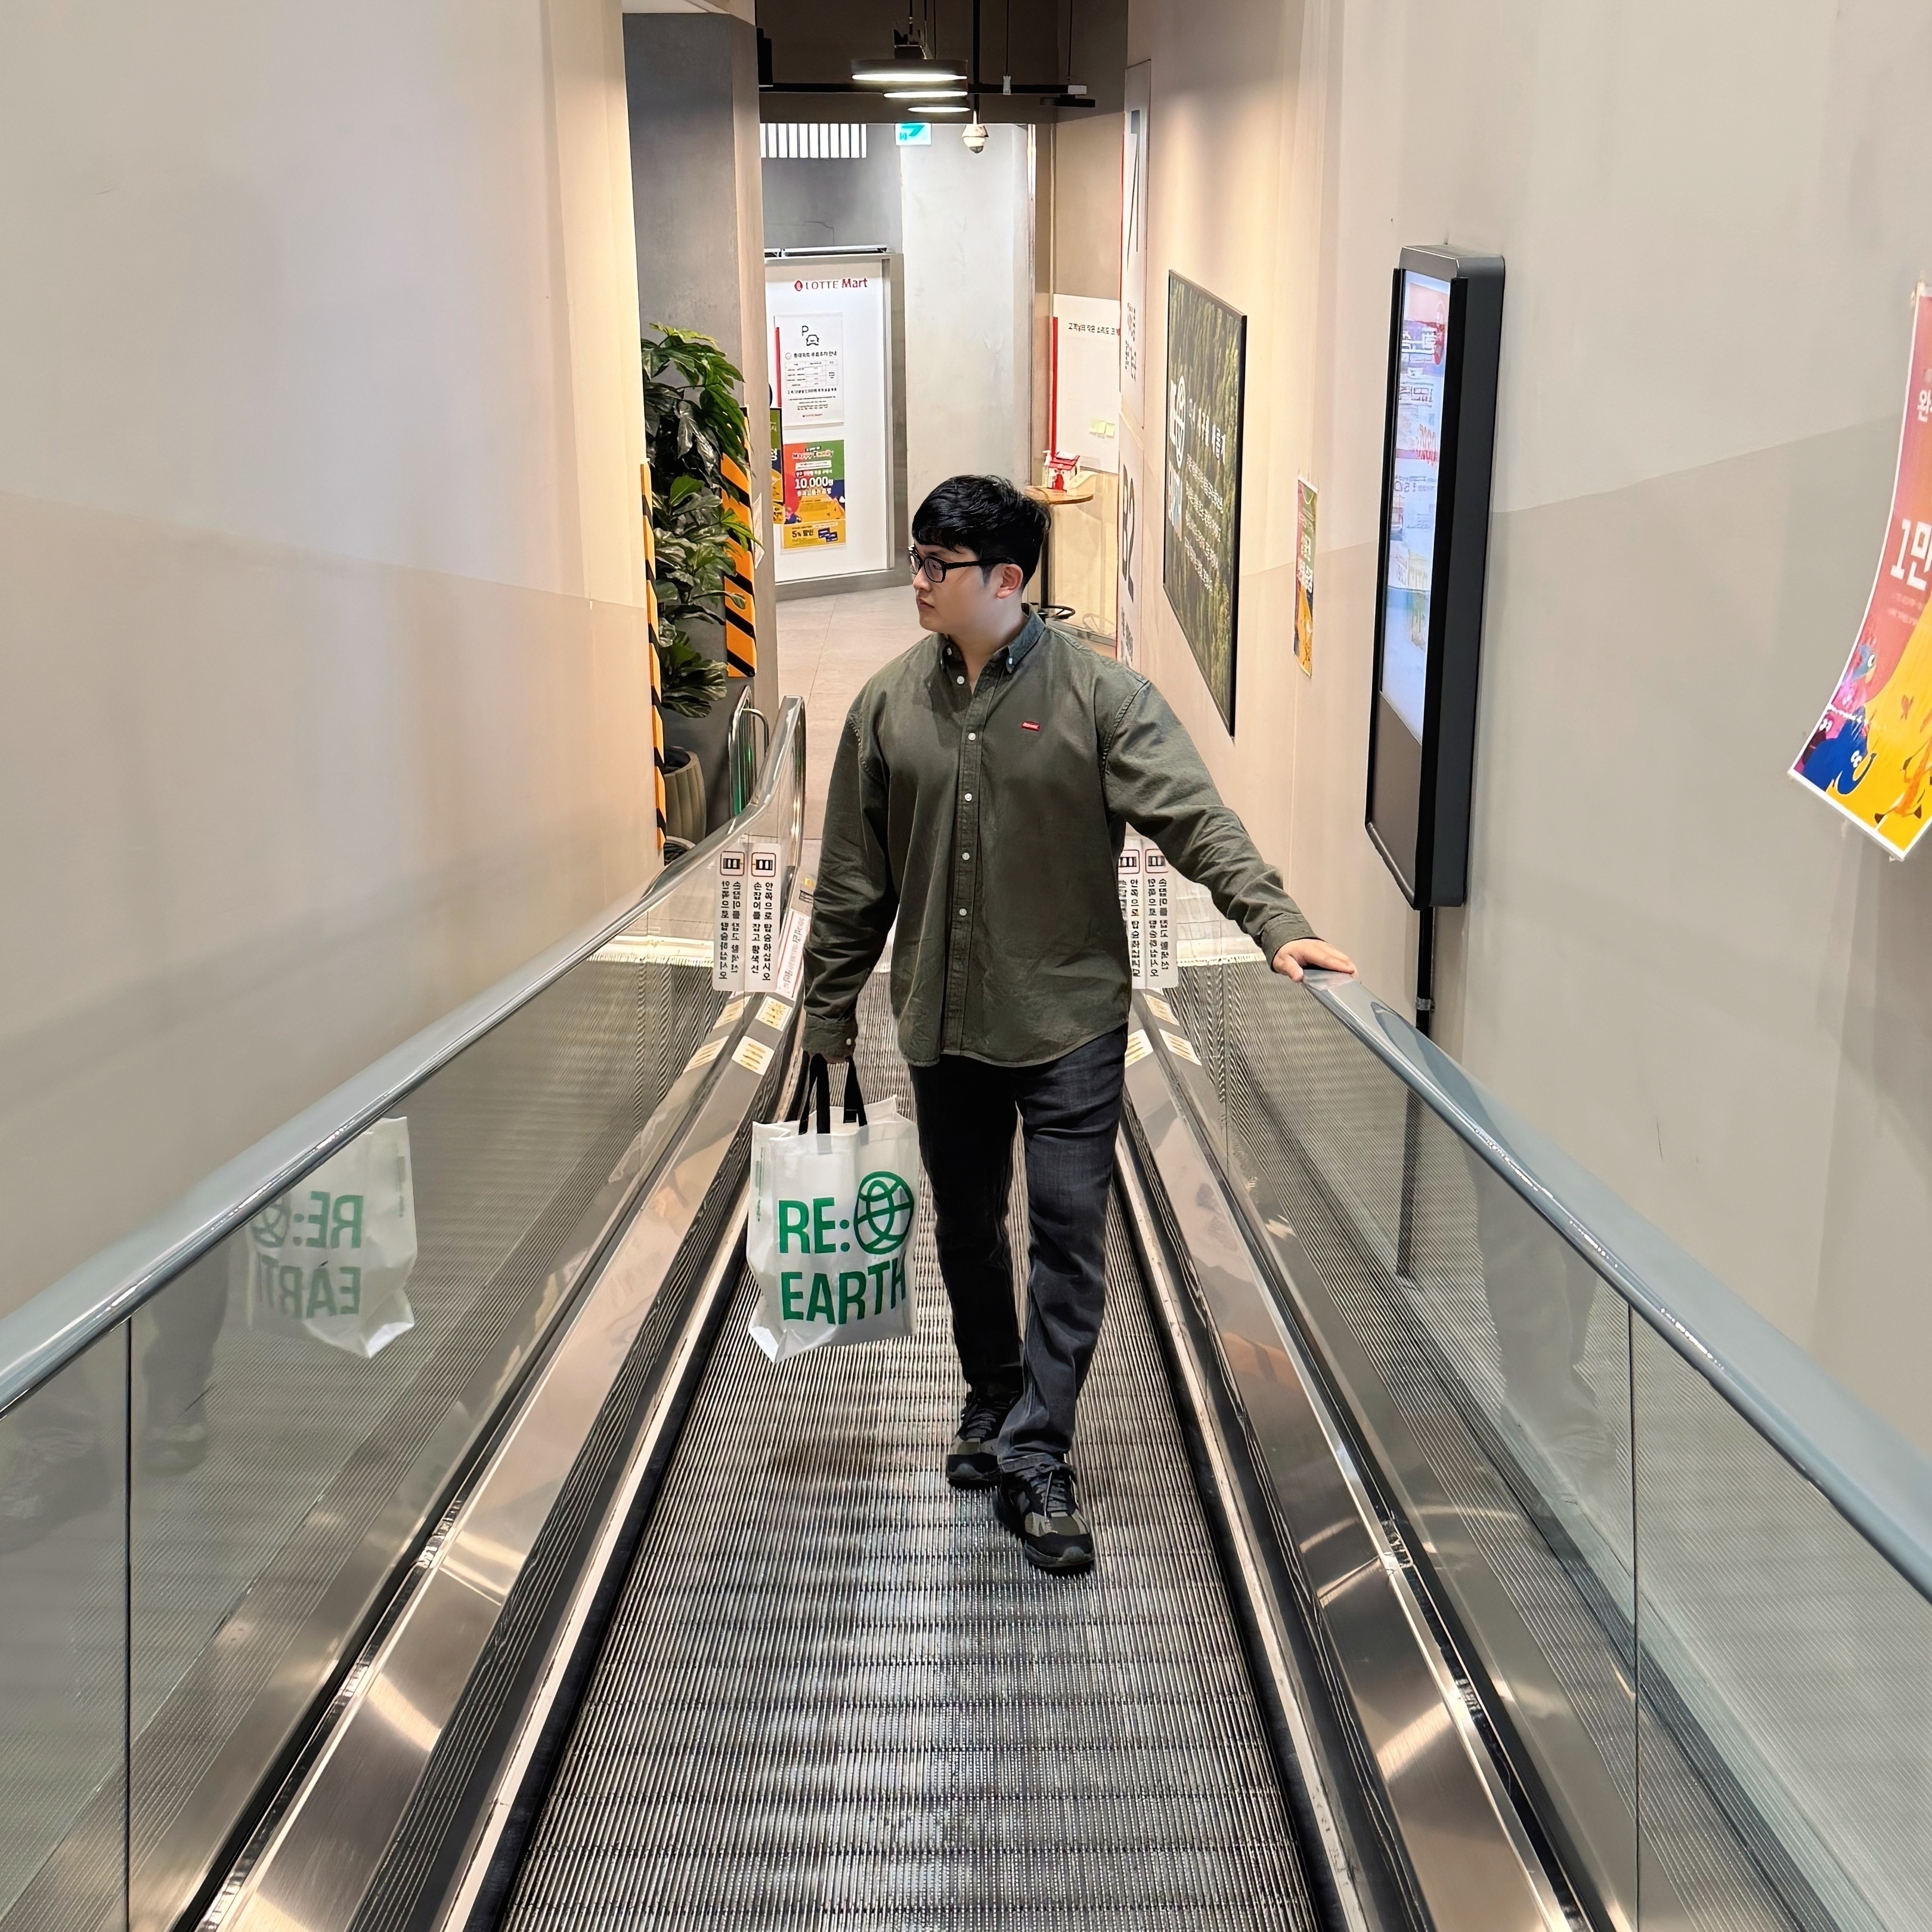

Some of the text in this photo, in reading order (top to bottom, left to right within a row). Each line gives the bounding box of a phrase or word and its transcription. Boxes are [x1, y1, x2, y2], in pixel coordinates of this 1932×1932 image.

[806, 277, 868, 290] LOTTE Mart
[1917, 389, 1932, 423] 완
[1122, 464, 1134, 603] B2
[781, 1251, 906, 1326] EARTH
